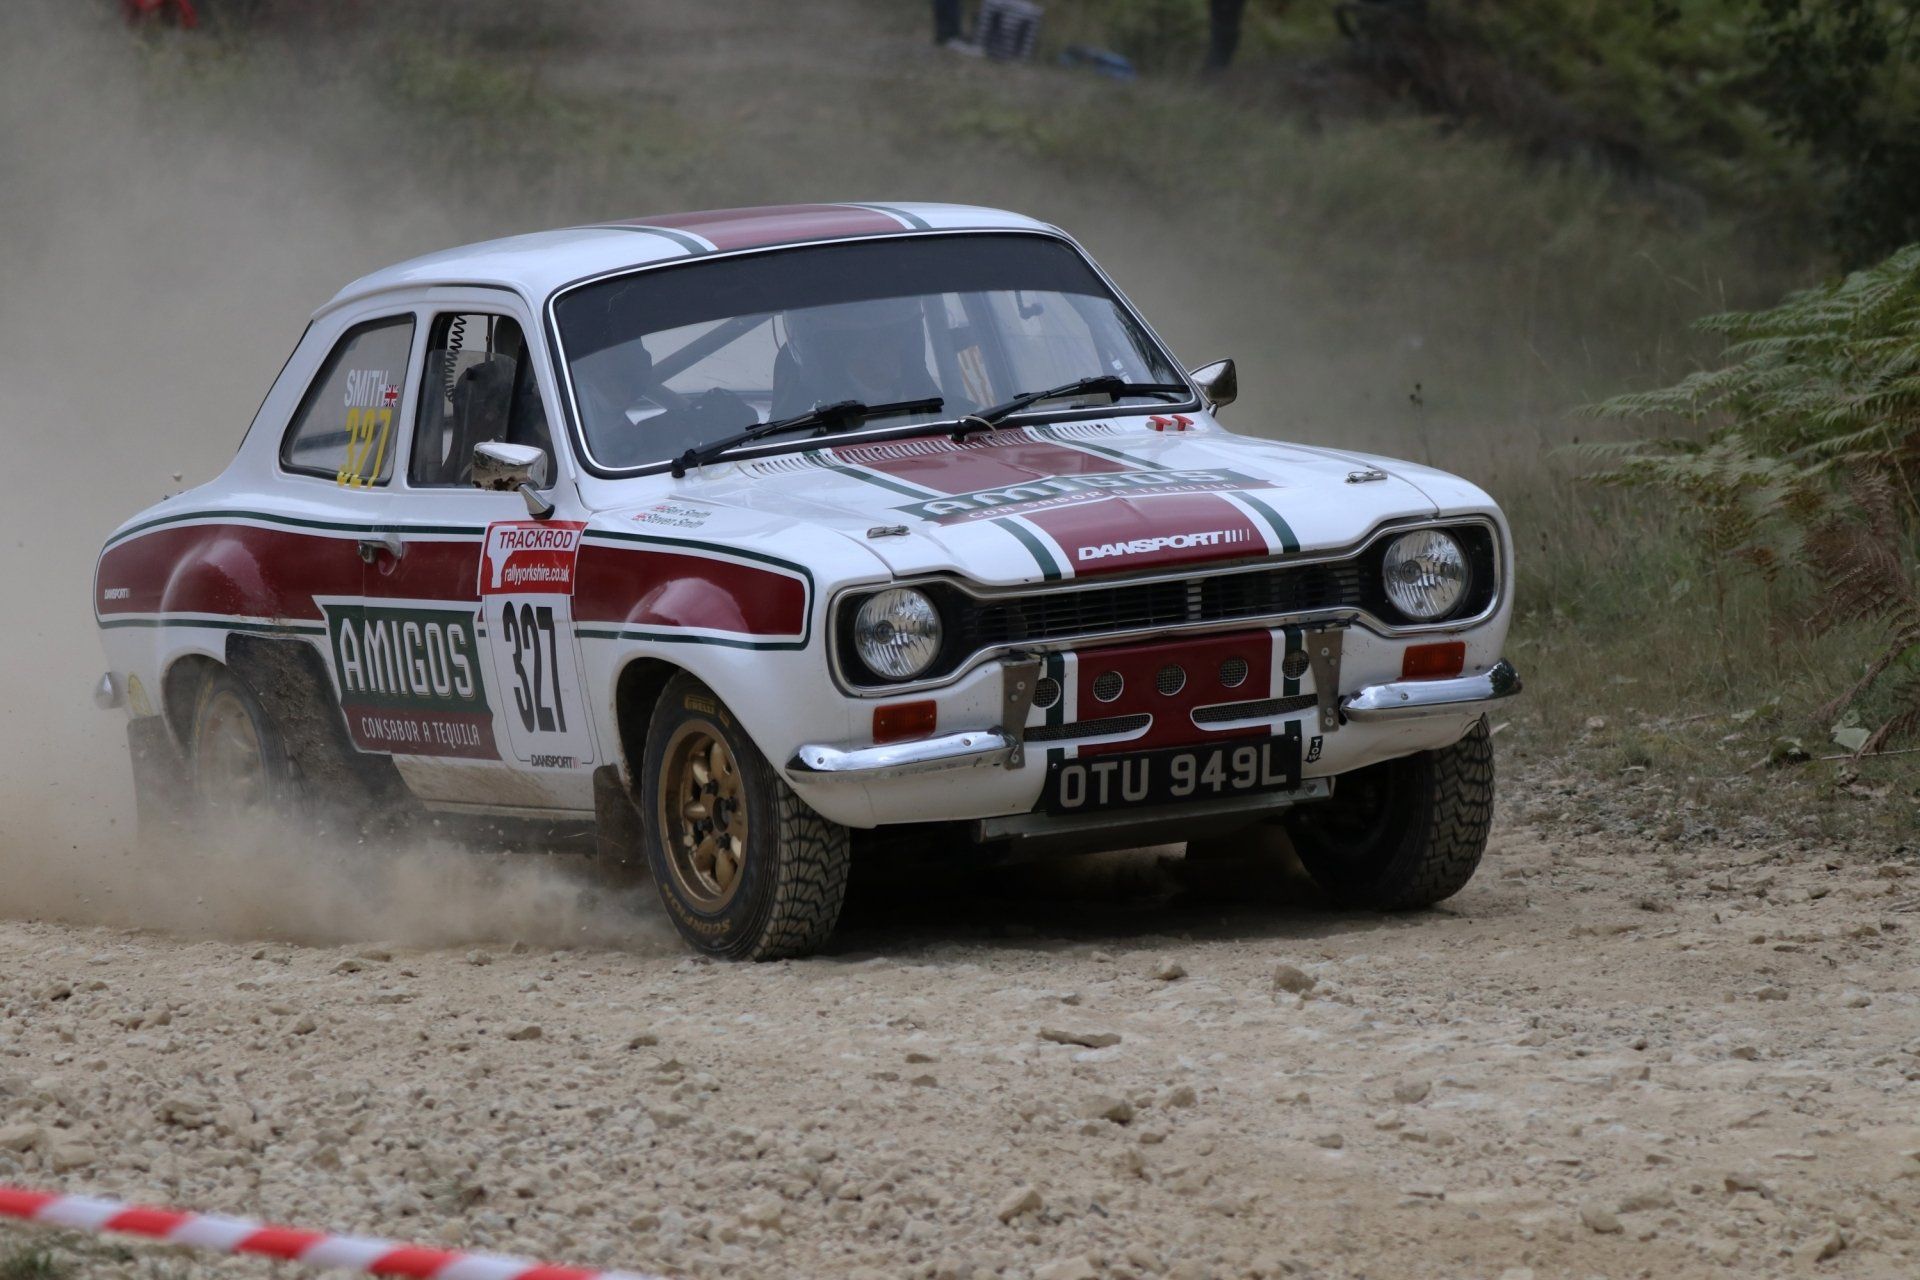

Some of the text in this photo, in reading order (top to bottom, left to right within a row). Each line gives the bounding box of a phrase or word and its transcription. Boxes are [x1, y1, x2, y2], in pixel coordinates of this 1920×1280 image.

[344, 369, 388, 407] SMITH
[337, 407, 392, 489] 327
[922, 471, 1227, 515] AMIGOS
[968, 506, 1017, 519] CON
[1022, 490, 1104, 508] SABOR
[1138, 483, 1240, 494] TEQUILA
[500, 530, 573, 549] TRACKROD
[504, 563, 570, 586] rallyyorkshire.co.uk
[339, 617, 474, 698] AMIGOS
[502, 601, 567, 733] 327
[422, 721, 432, 743] A
[432, 722, 481, 749] TEQUILA
[1308, 739, 1322, 762] TOW
[1060, 743, 1287, 808] OTU 949L
